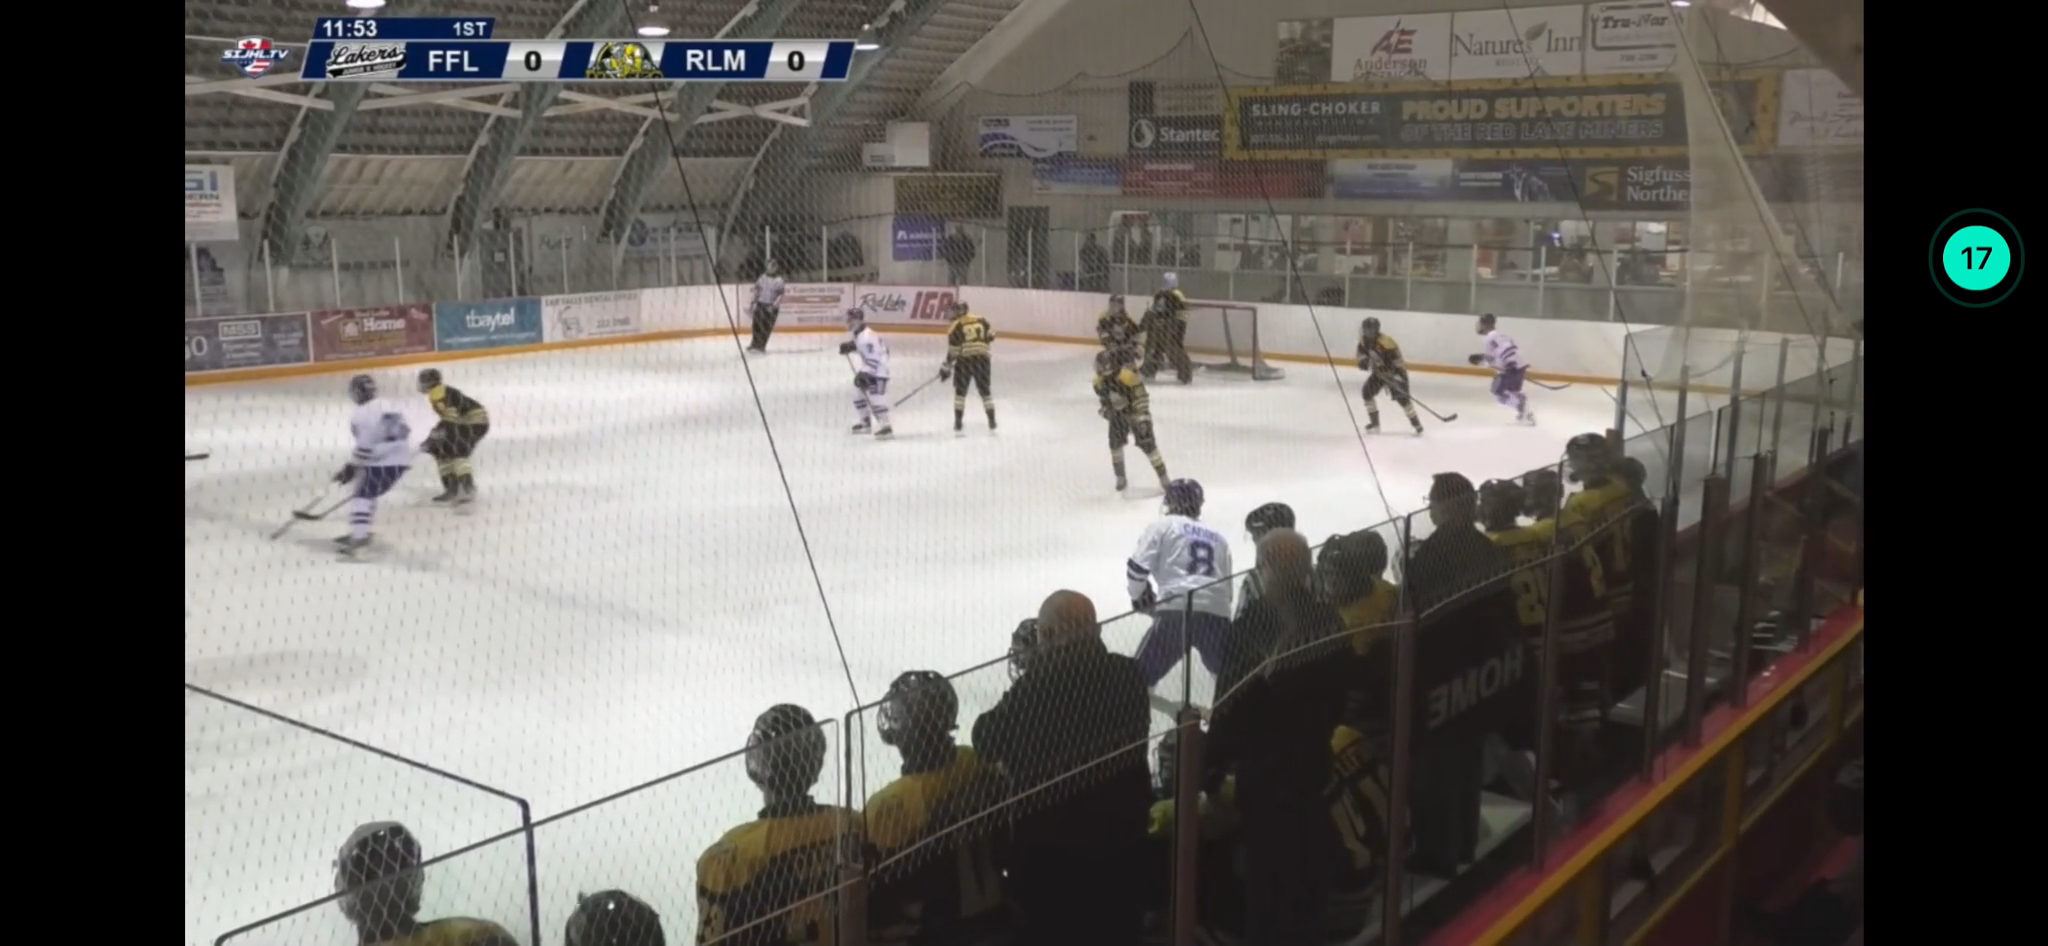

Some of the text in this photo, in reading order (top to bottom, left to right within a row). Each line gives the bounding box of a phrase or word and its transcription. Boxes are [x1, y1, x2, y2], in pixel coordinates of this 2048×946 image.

[1353, 57, 1428, 71] Anderson
[1252, 101, 1381, 117] SLING-CHOKER
[1402, 93, 1666, 120] PROUD SUPPORTERS
[1159, 126, 1220, 143] Stantec
[1401, 124, 1428, 141] OF
[1432, 122, 1472, 140] THE
[1476, 122, 1515, 140] RED
[1521, 121, 1574, 140] LAKE
[1579, 120, 1664, 139] MINERS
[910, 291, 954, 320] IGA
[363, 317, 406, 332] Home
[466, 307, 515, 332] tbaytel
[1186, 540, 1215, 577] 8
